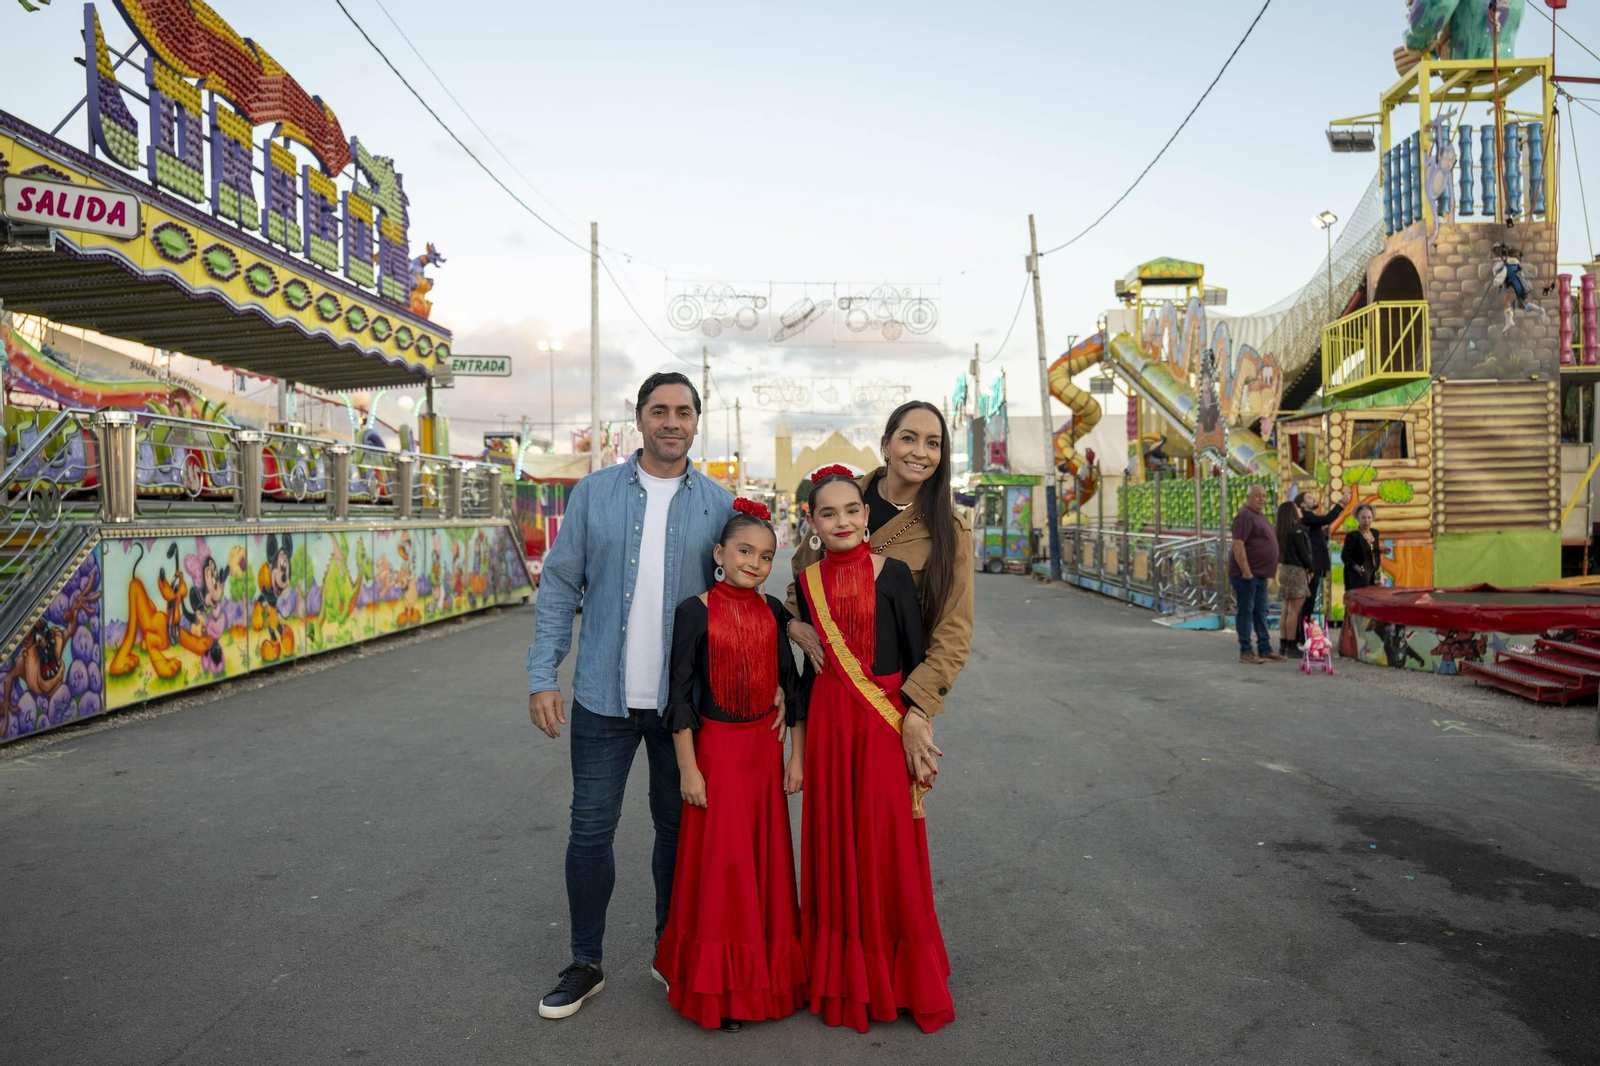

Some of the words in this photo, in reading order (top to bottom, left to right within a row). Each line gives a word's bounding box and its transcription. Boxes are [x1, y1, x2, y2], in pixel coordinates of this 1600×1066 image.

[17, 187, 126, 227] SALIDA
[129, 360, 157, 378] SUPER
[451, 359, 505, 372] ENTRADA
